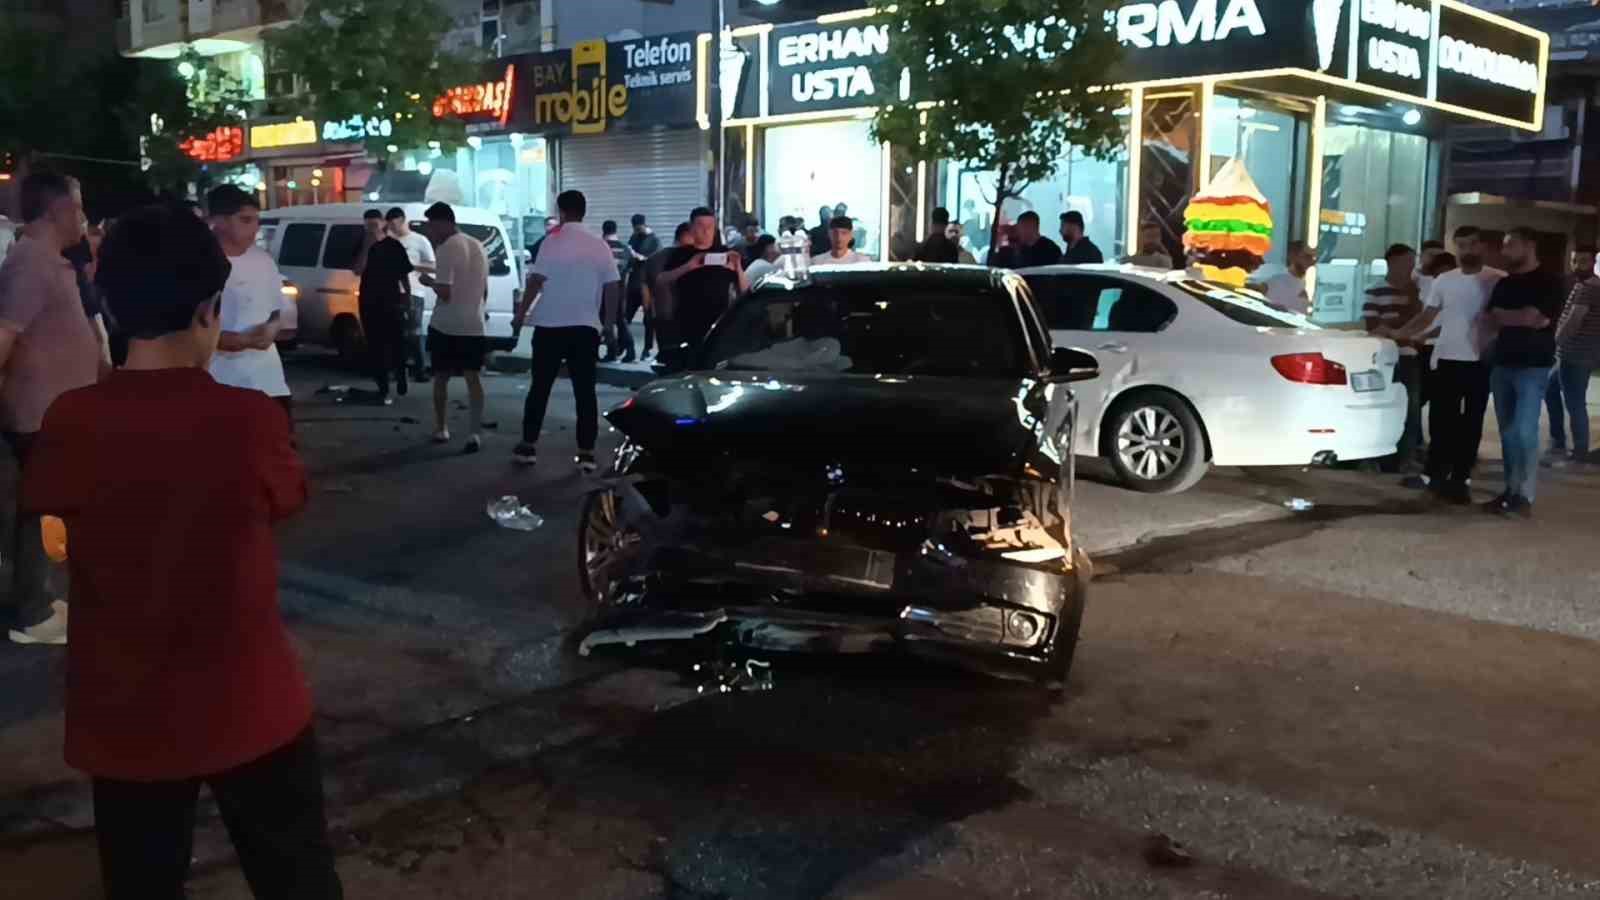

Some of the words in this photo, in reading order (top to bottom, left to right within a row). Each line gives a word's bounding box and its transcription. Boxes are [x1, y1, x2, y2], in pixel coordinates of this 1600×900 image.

[623, 38, 691, 69] Telefon
[778, 26, 889, 66] ERHAN
[533, 65, 566, 88] BAY
[623, 72, 658, 89] Teknik
[659, 67, 692, 87] servis
[791, 66, 874, 102] USTA
[534, 78, 629, 125] mobile
